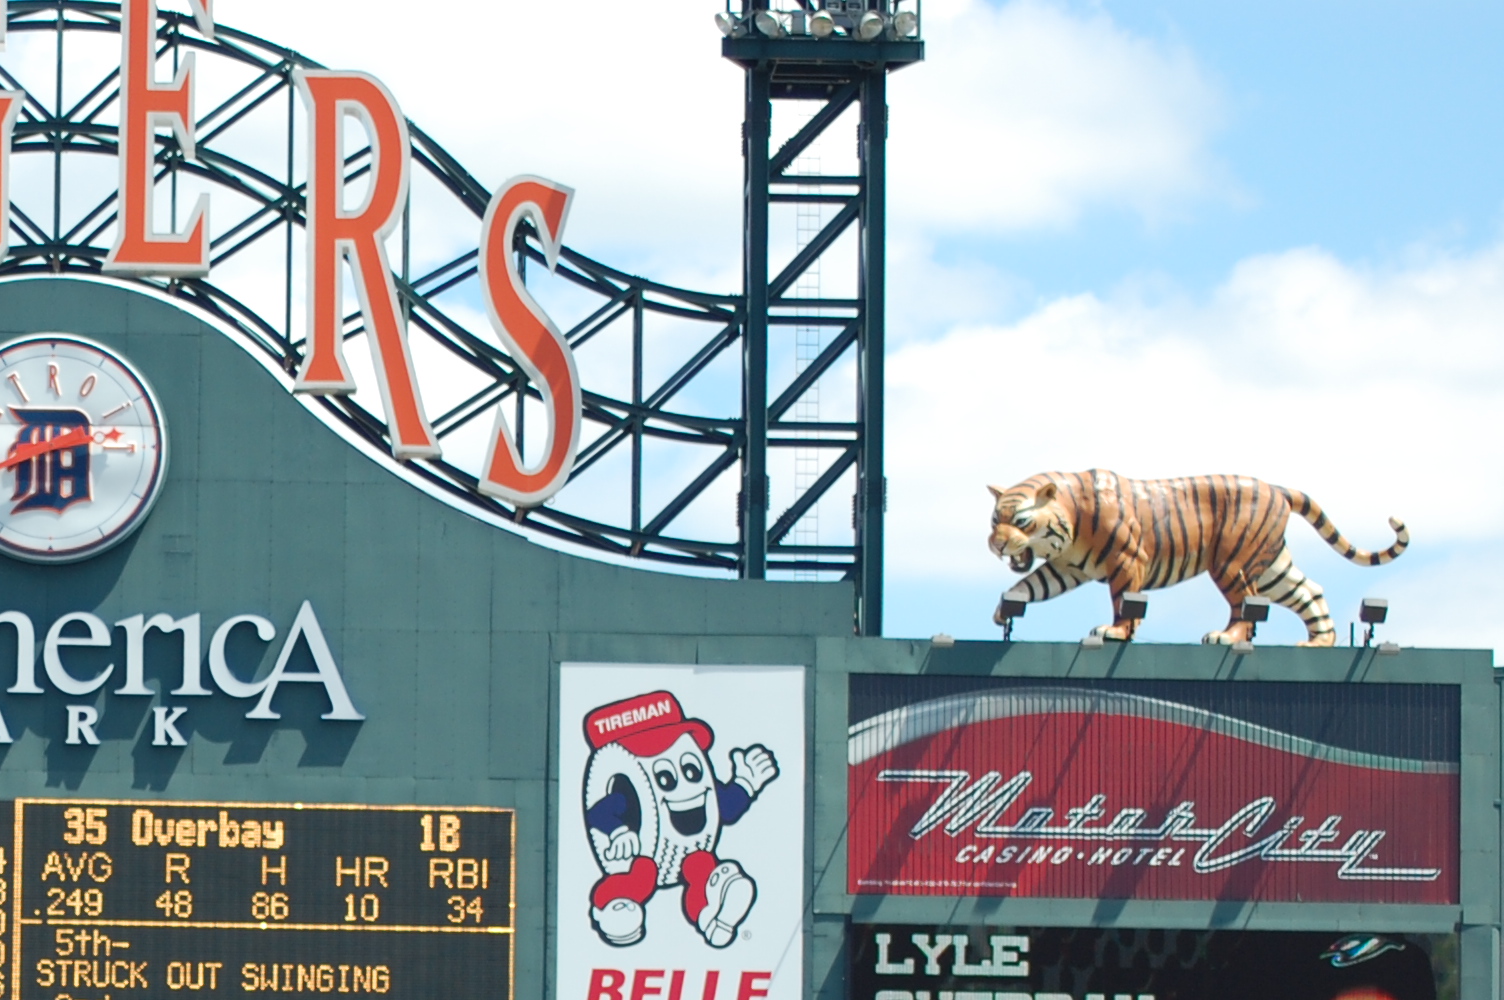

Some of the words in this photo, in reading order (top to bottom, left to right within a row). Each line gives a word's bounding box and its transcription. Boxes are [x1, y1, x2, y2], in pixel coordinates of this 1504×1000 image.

[593, 700, 672, 735] TIREMAN
[63, 808, 107, 846] 35
[131, 809, 284, 849] Overbay
[420, 814, 461, 852] 1B
[41, 851, 113, 882] AVG
[335, 856, 389, 888] HR
[428, 858, 489, 889] RBI
[956, 844, 1070, 866] CASINO
[1088, 846, 1185, 869] HOTEL
[33, 887, 103, 917] .249
[155, 890, 193, 918] 48
[252, 892, 289, 920] 86
[344, 894, 380, 922] 10
[446, 896, 484, 924] 34
[54, 928, 130, 957] 5th-
[874, 932, 1029, 977] LYLE
[35, 960, 148, 989] STRUCK
[166, 961, 223, 990] OUT
[241, 963, 391, 993] SWINGING
